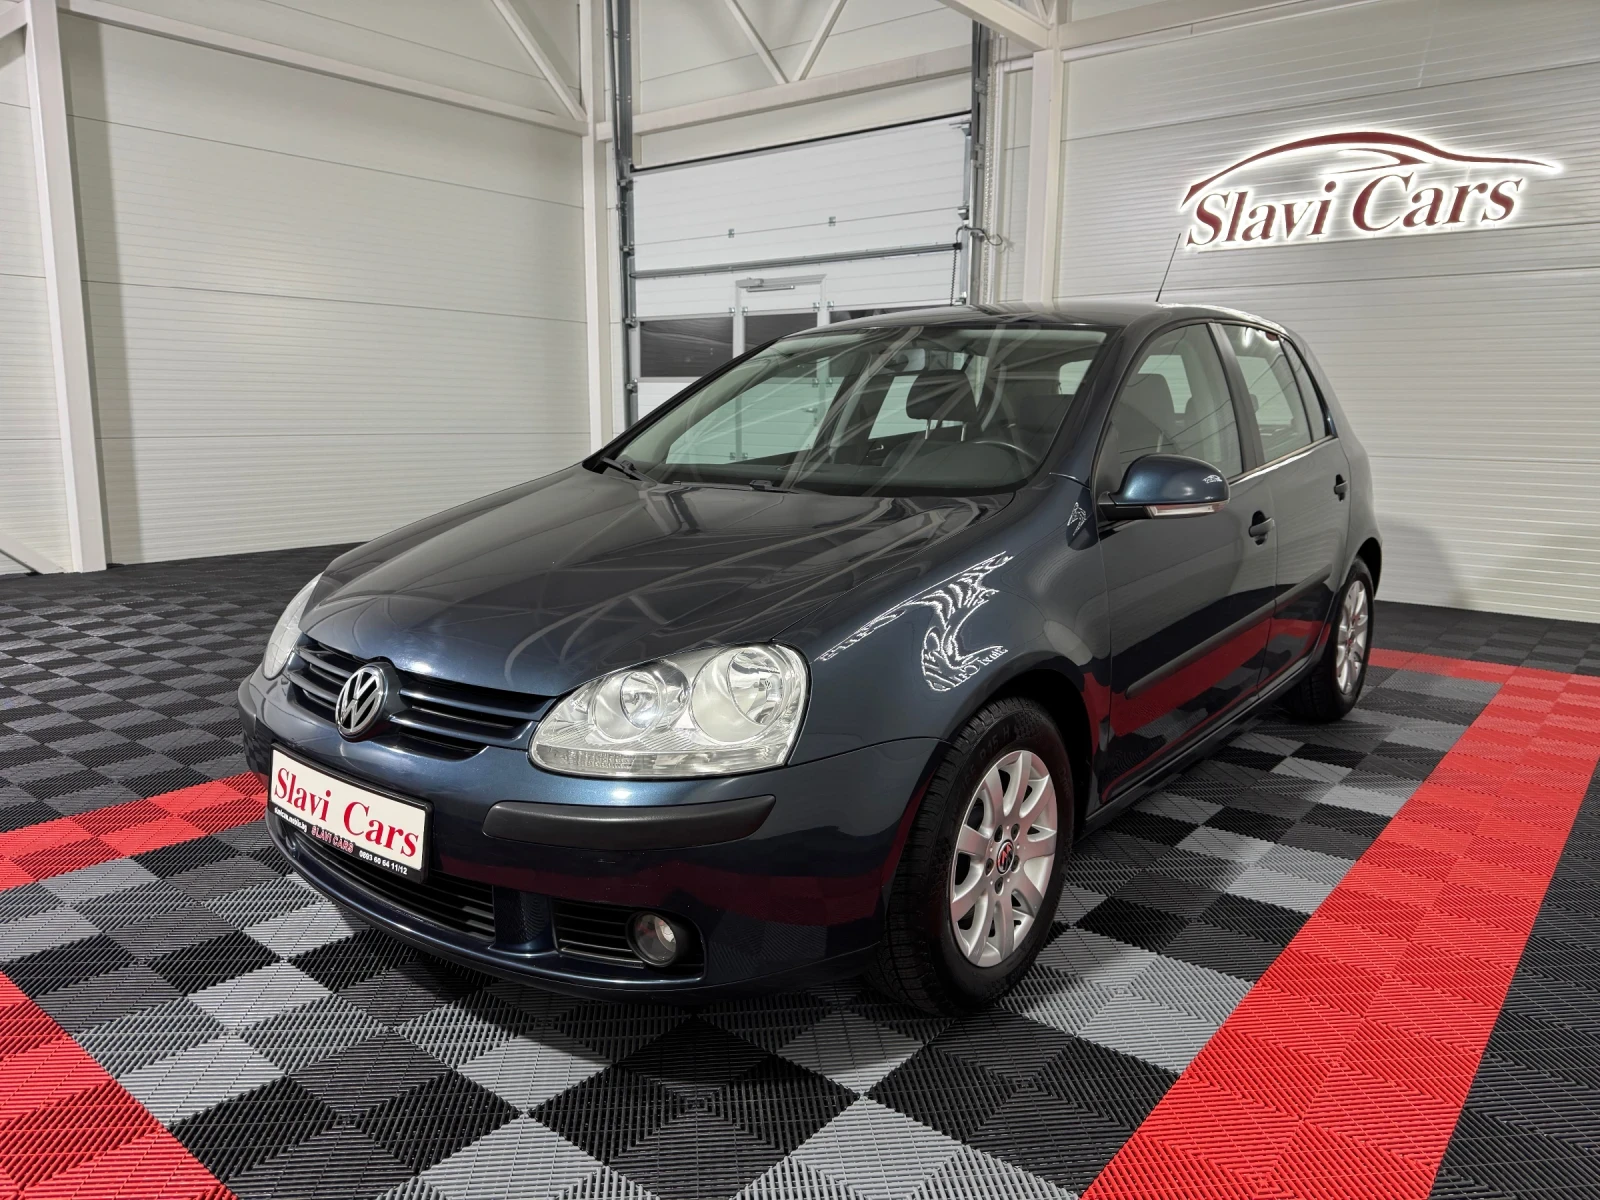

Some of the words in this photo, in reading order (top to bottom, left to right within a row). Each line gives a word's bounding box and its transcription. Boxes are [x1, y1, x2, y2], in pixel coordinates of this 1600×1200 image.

[1186, 180, 1337, 246] Slavi
[1352, 171, 1524, 232] Cars
[274, 767, 332, 822] Slavi
[343, 801, 419, 858] Cars
[311, 825, 333, 844] SLAVI
[332, 834, 354, 854] CARS
[391, 862, 408, 875] 11/12
